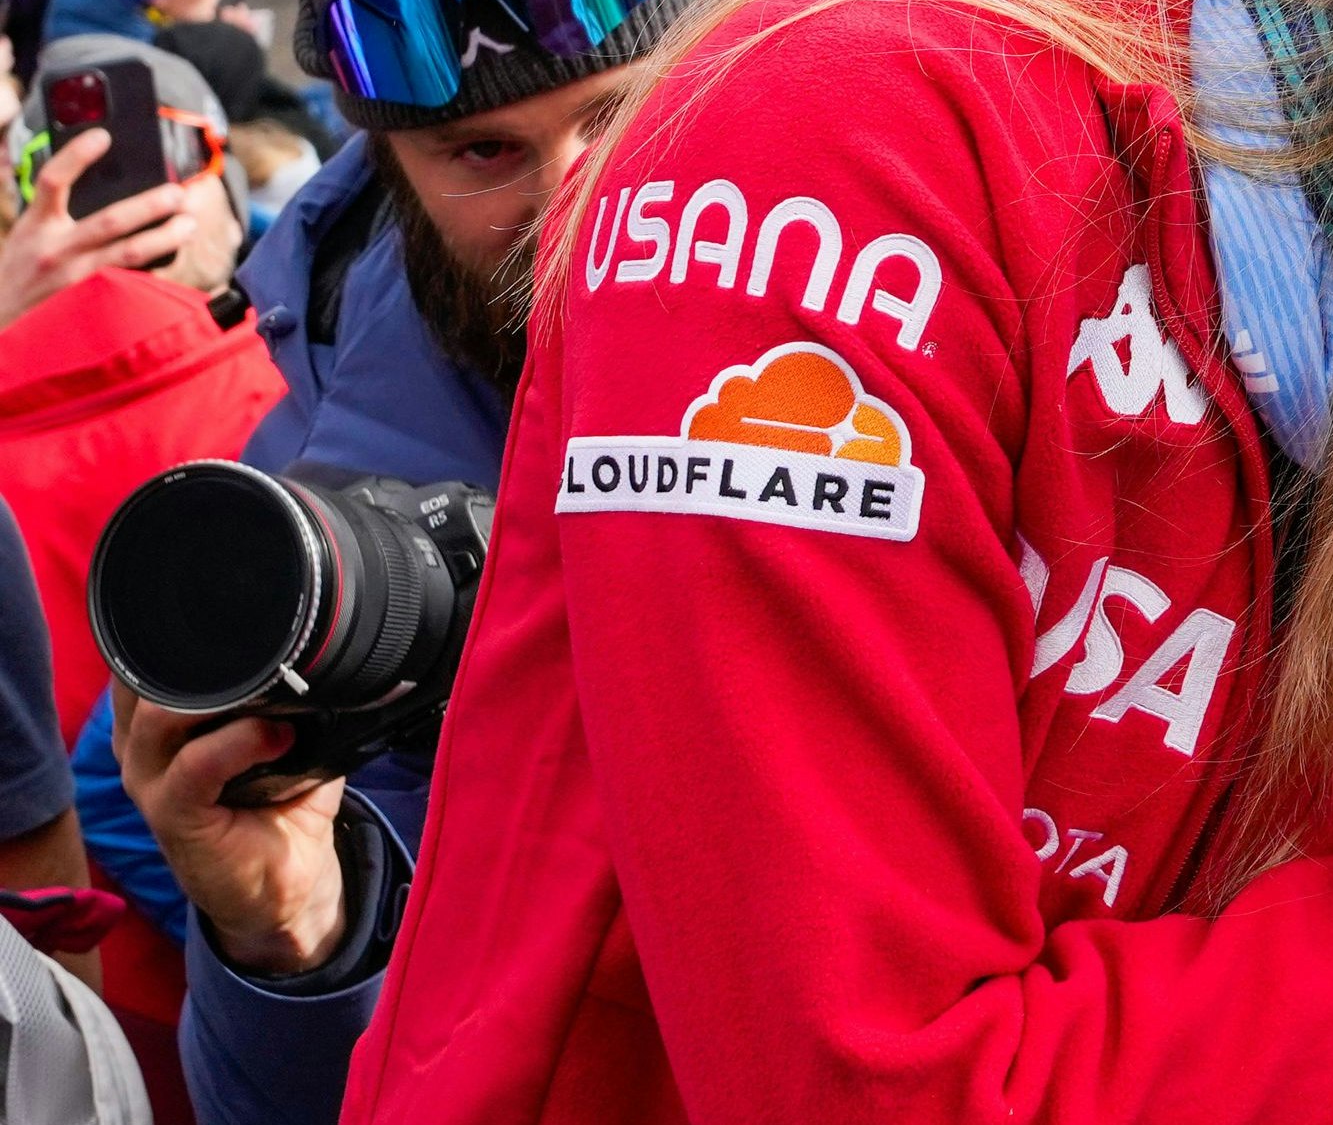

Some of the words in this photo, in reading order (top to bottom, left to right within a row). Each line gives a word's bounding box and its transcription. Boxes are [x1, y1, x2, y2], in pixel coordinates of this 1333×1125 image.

[585, 178, 943, 352] USANA
[420, 493, 450, 515] EOS
[559, 454, 896, 521] LOUDFLARE
[428, 510, 448, 529] R5
